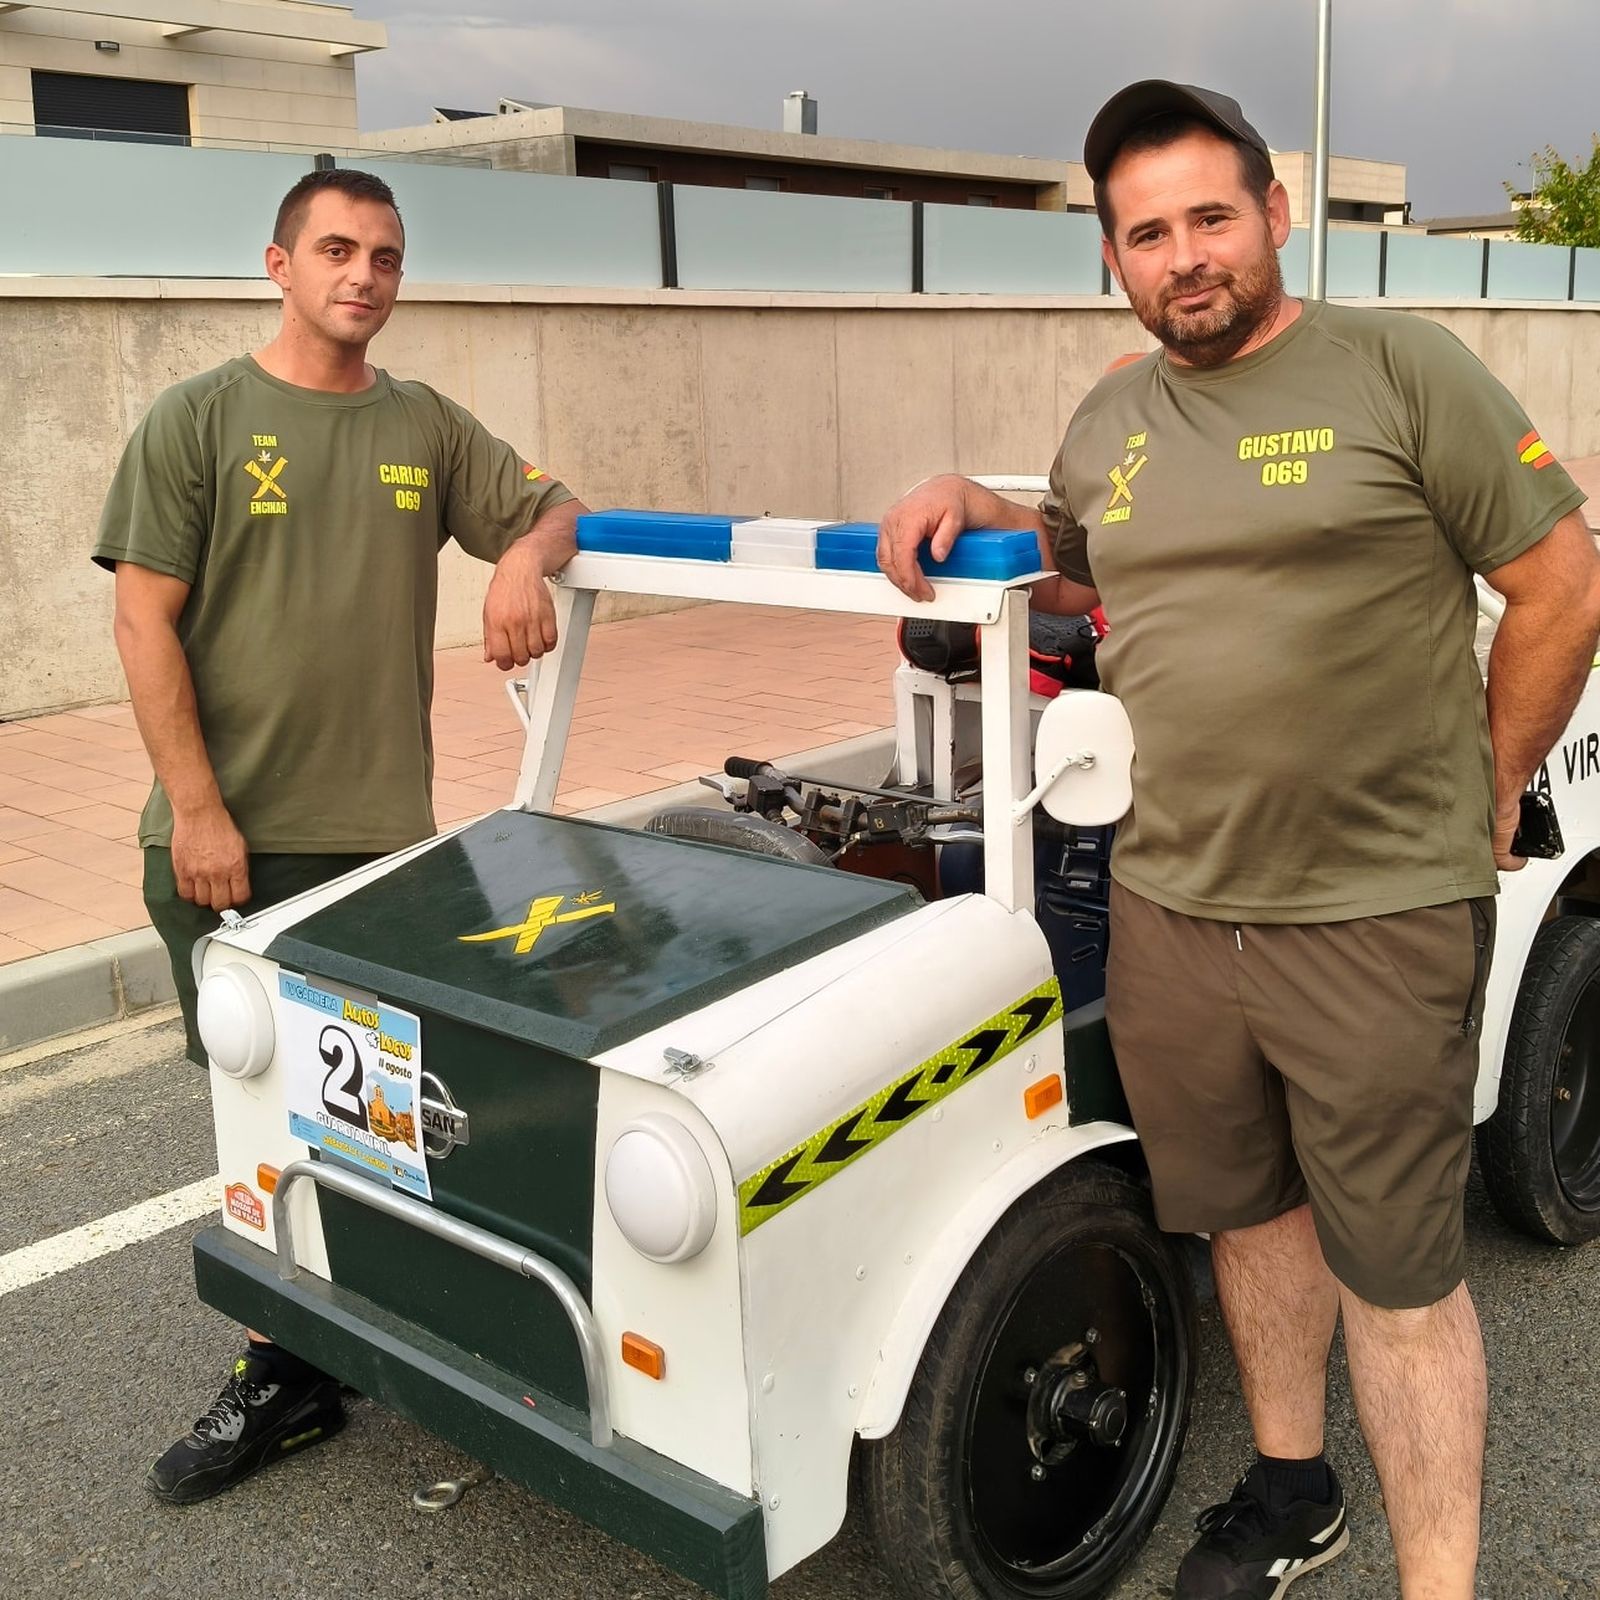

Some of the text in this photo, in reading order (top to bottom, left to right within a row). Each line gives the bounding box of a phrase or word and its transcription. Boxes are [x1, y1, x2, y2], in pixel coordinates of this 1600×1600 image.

[252, 434, 277, 447] TEAM
[1238, 428, 1334, 460] GUSTAVO
[379, 464, 429, 488] CARLOS
[1262, 460, 1307, 486] 069
[395, 490, 420, 511] 069
[296, 986, 339, 1012] CARRERA
[319, 1024, 370, 1133] 2
[385, 1062, 412, 1079] agosto
